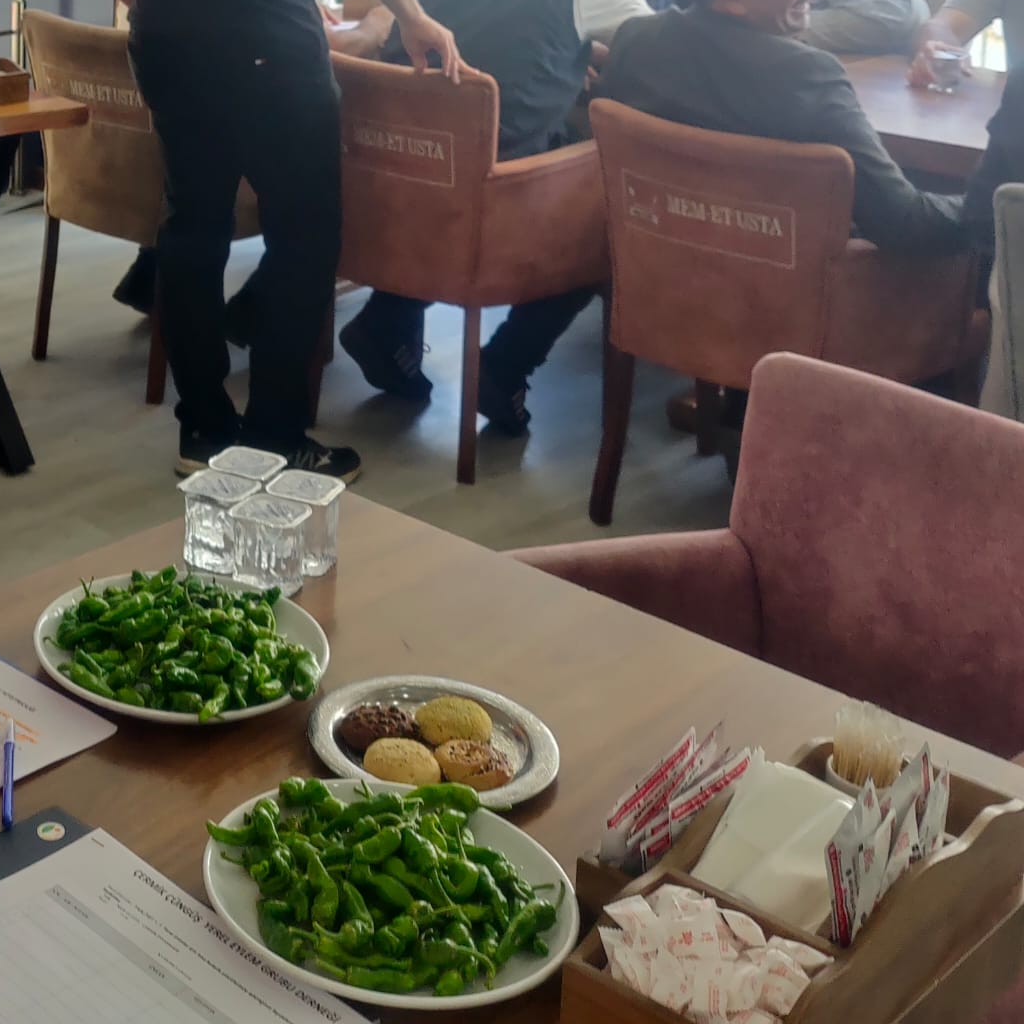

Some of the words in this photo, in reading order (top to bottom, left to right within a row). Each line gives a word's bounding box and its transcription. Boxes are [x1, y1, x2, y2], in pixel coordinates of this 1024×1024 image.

[113, 86, 143, 108] USTA
[407, 137, 445, 161] USTA
[736, 209, 783, 237] USTA
